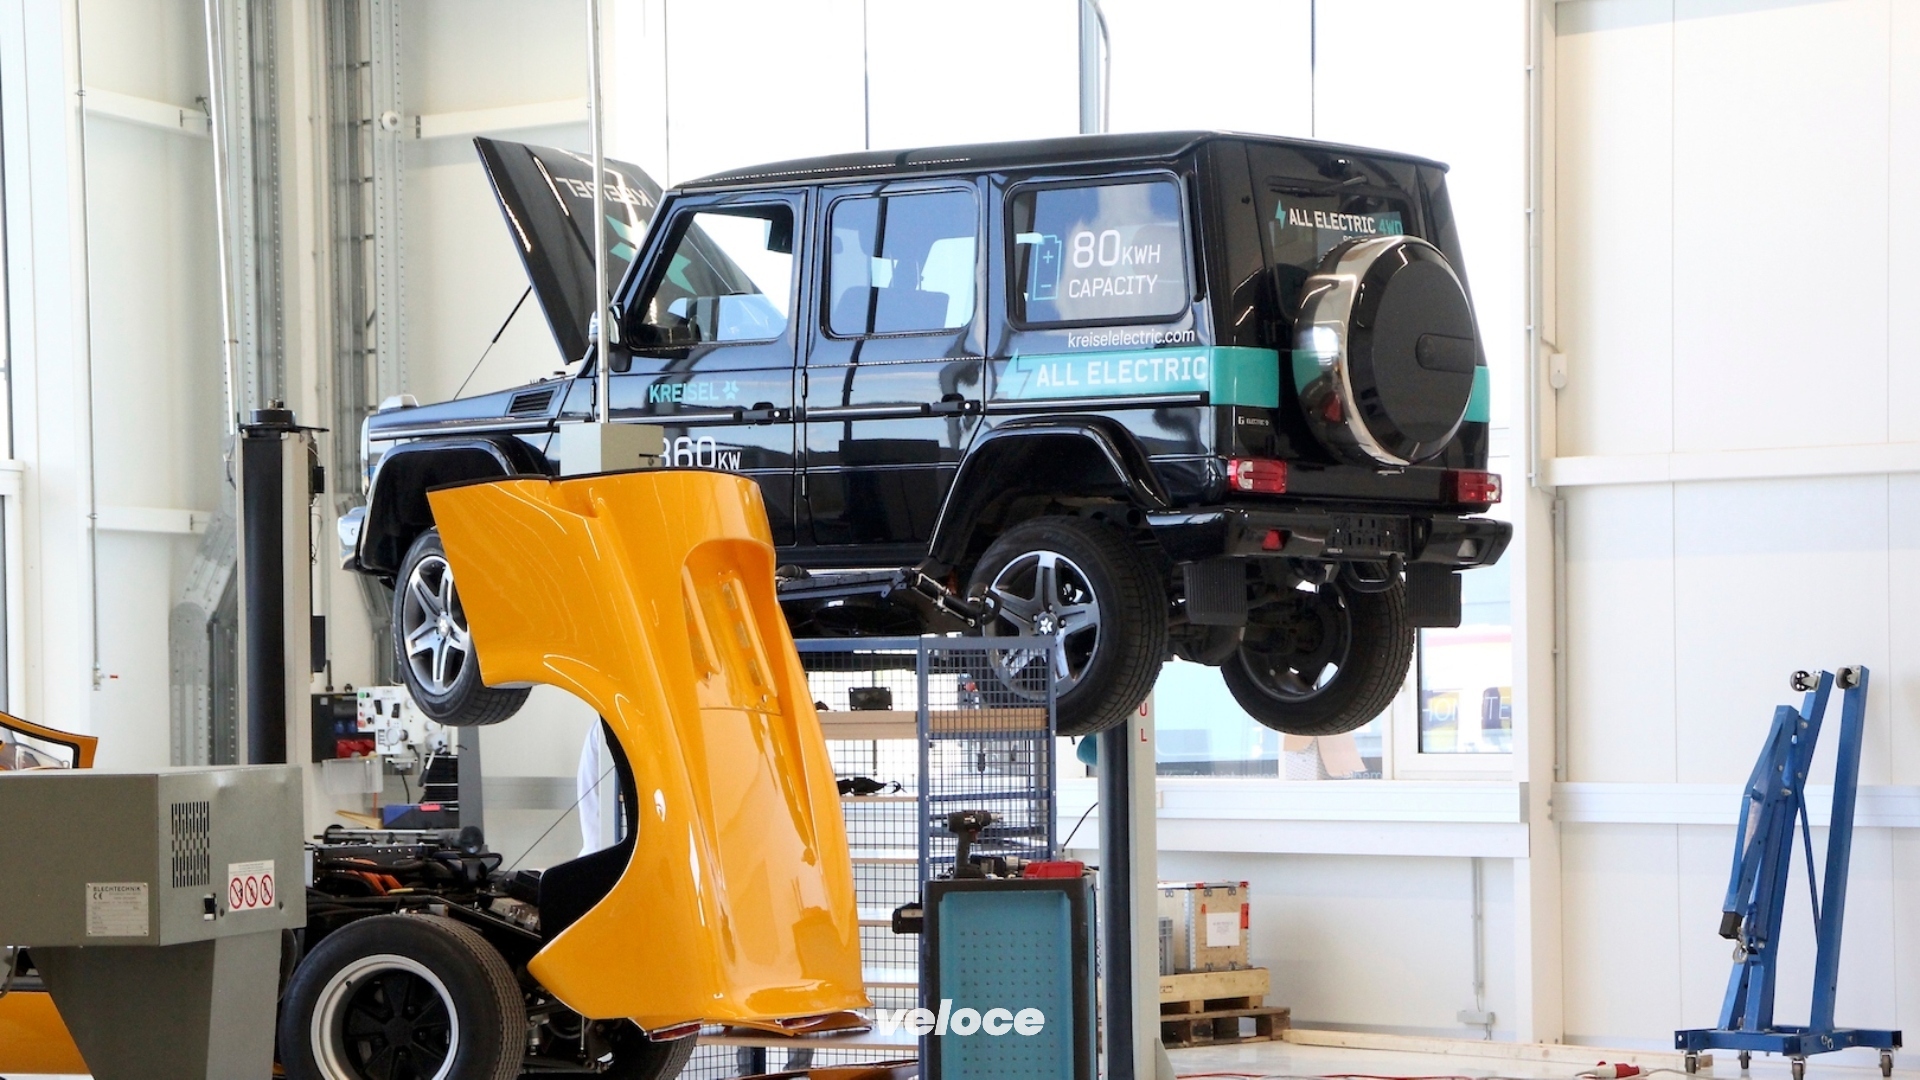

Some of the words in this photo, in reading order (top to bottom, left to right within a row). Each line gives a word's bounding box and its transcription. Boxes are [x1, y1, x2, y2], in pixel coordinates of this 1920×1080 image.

[1289, 207, 1314, 227] ALL
[1314, 210, 1377, 234] ELECTRIC
[1069, 274, 1158, 298] CAPACITY
[1068, 328, 1195, 348] kreiselelectric.com
[1036, 362, 1080, 388] ALL
[1087, 357, 1208, 385] ELECTRIC
[649, 382, 720, 405] KREISEL
